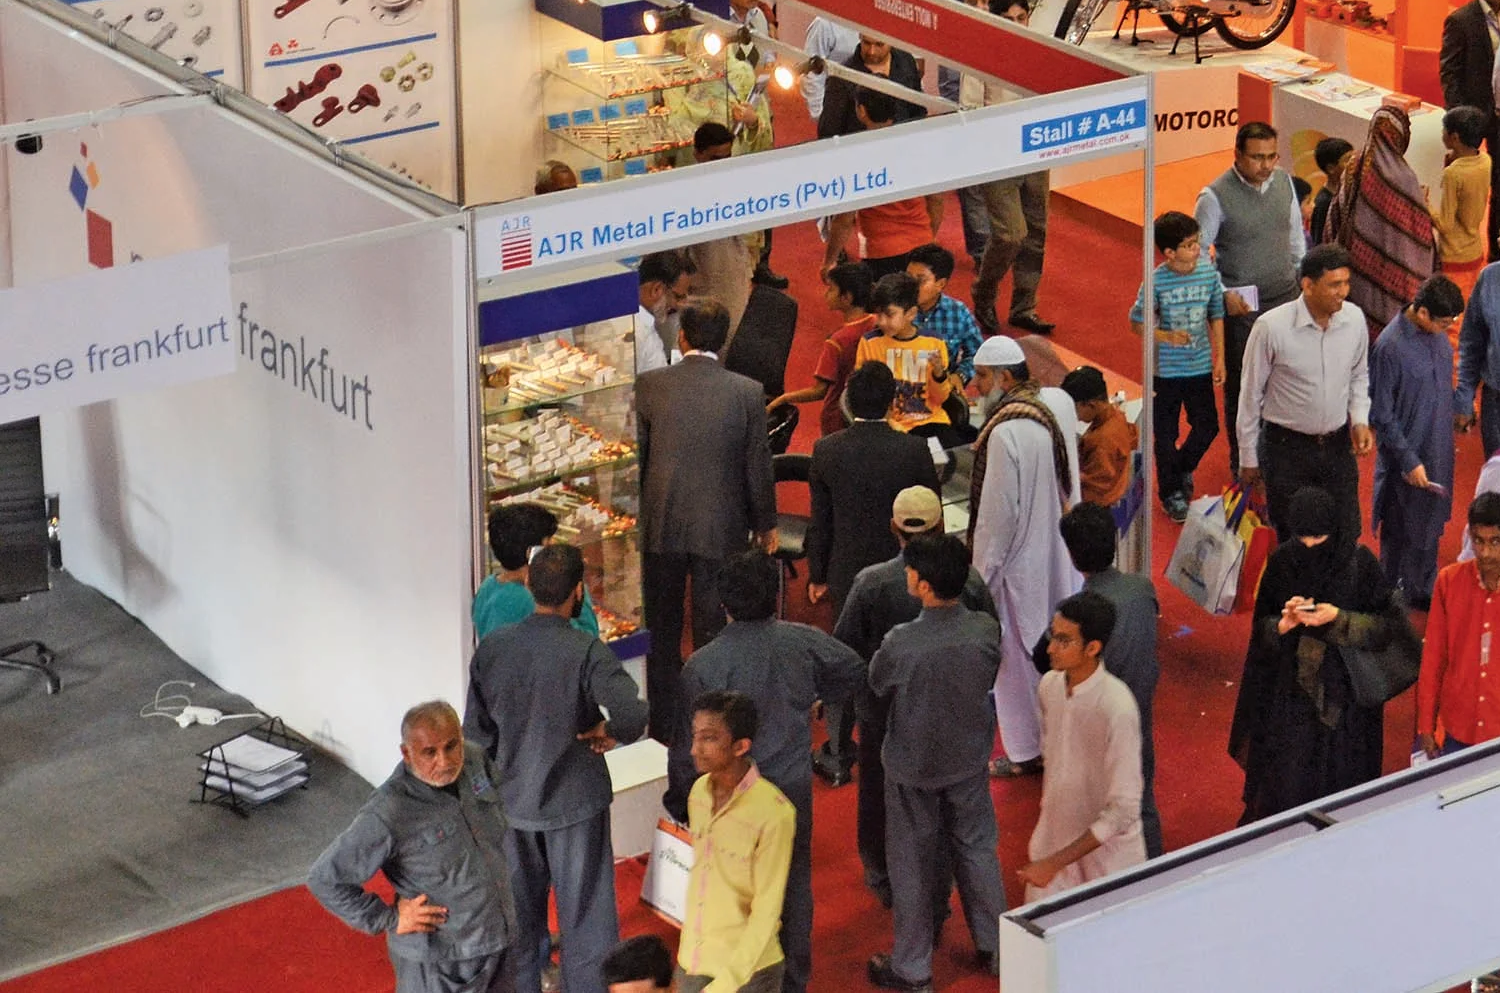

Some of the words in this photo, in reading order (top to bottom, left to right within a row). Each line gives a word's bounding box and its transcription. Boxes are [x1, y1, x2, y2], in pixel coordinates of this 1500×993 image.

[1029, 121, 1073, 146] Stall
[1077, 115, 1093, 135] #
[1096, 107, 1136, 132] A-44
[502, 215, 531, 231] AJR
[538, 232, 584, 258] AJR
[592, 216, 655, 248] Metal
[663, 193, 790, 232] Fabricators
[796, 175, 846, 208] (Pvt)
[853, 167, 894, 193] Ltd.
[0, 358, 73, 395] esse
[85, 316, 230, 374] frankfurt
[238, 301, 374, 431] frankfurt
